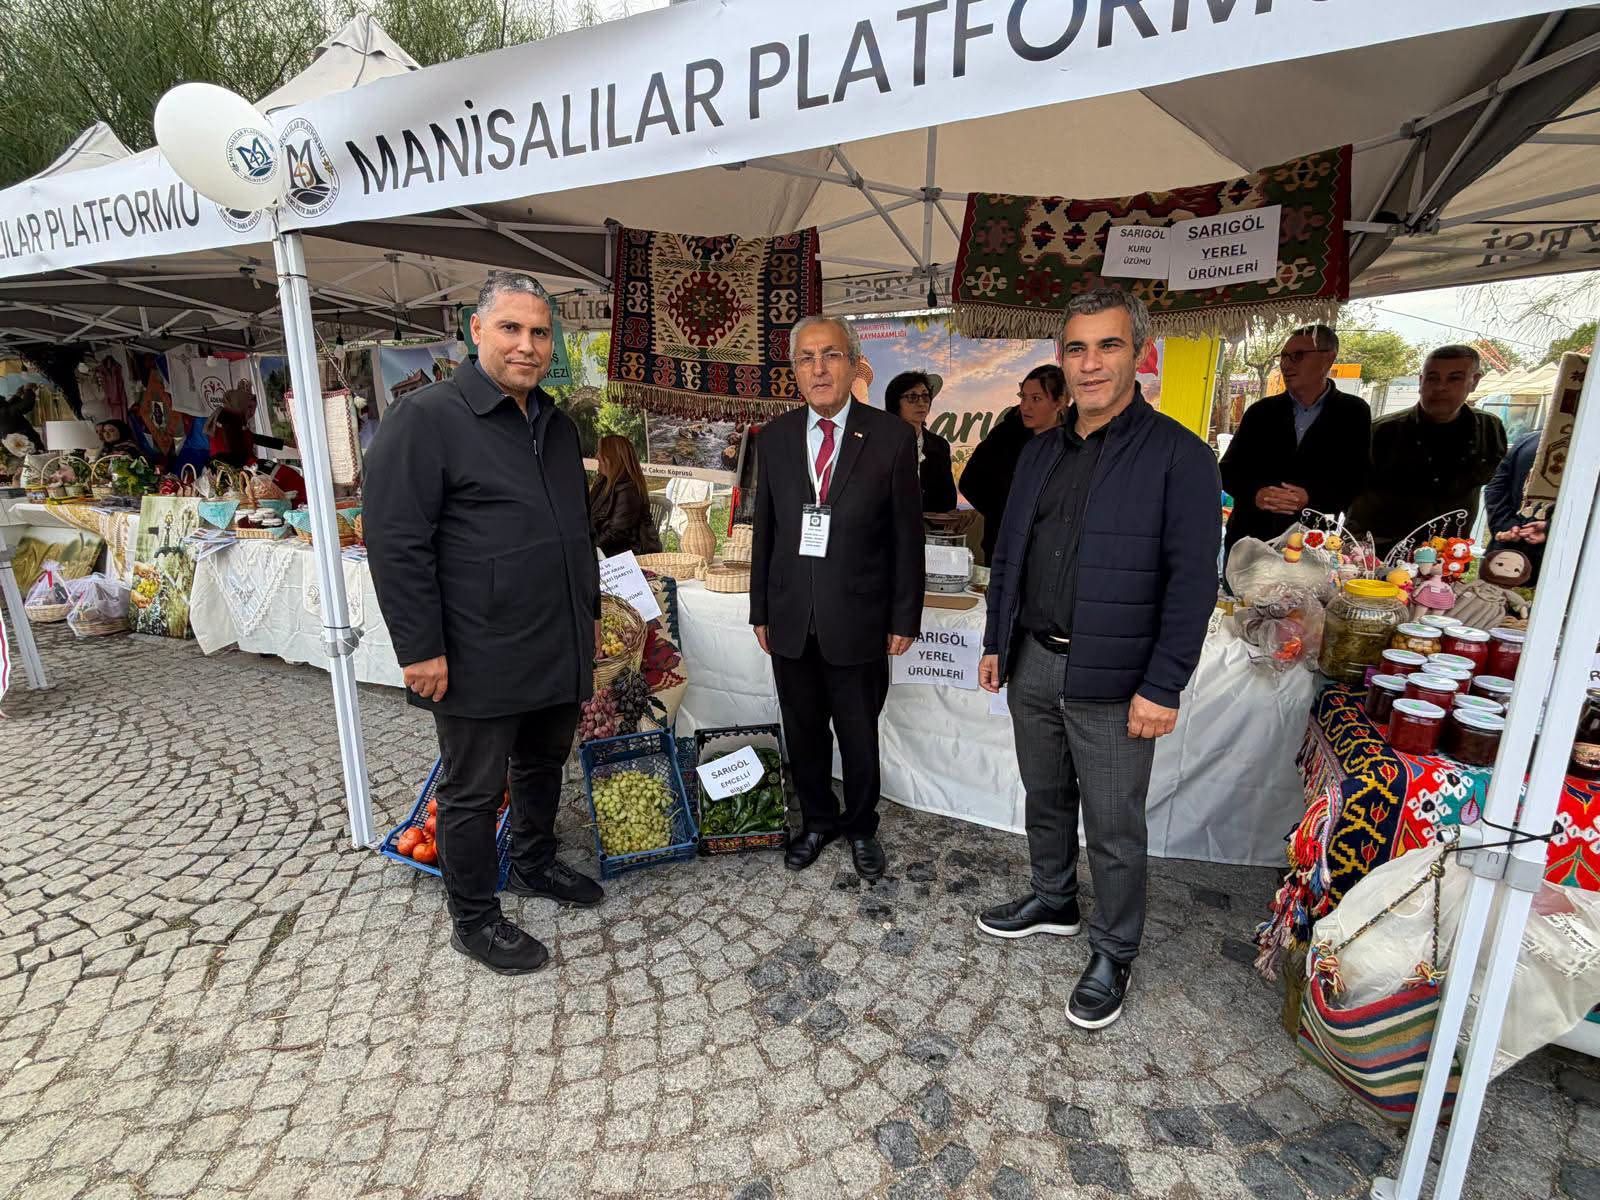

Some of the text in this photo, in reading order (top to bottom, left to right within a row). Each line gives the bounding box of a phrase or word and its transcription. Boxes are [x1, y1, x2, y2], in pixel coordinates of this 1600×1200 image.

[345, 0, 1328, 195] MANİSALILAR PLATFOR
[0, 182, 200, 259] ILAR PLATFORMU
[1188, 215, 1264, 239] SARIGÖL
[1120, 228, 1166, 240] SARIGÖL
[1128, 244, 1152, 254] KURU
[1201, 244, 1247, 259] YEREL
[1123, 256, 1151, 266] ÜZÜMÜ
[1188, 259, 1258, 280] ÜRÜNLERİ
[547, 366, 570, 379] KEZİ
[918, 651, 955, 663] YEREL
[908, 665, 964, 680] ÜRÜNLERİ
[711, 759, 750, 779] SARIGÖL
